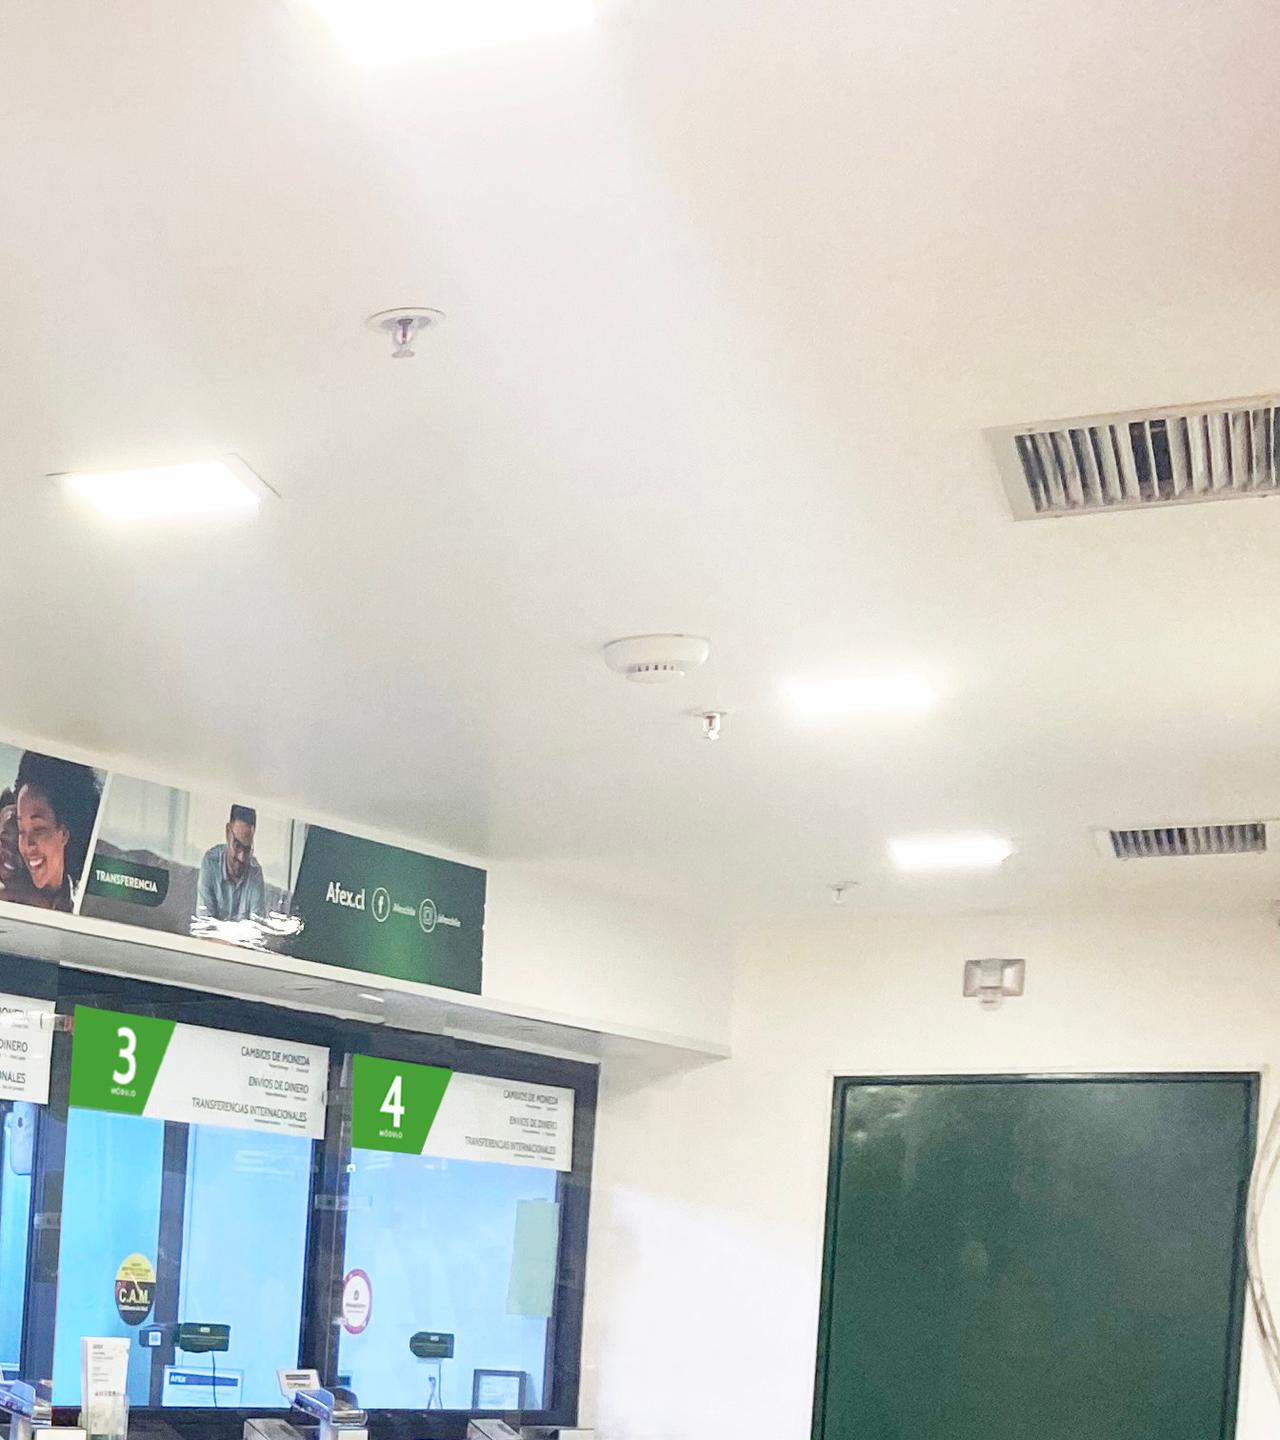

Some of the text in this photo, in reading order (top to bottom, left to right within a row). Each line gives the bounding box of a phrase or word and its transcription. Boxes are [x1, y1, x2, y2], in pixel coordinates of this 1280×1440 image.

[95, 869, 159, 894] TRANSFERENCIA
[112, 1026, 137, 1085] 3
[272, 1051, 281, 1061] DE
[379, 1074, 405, 1128] 4
